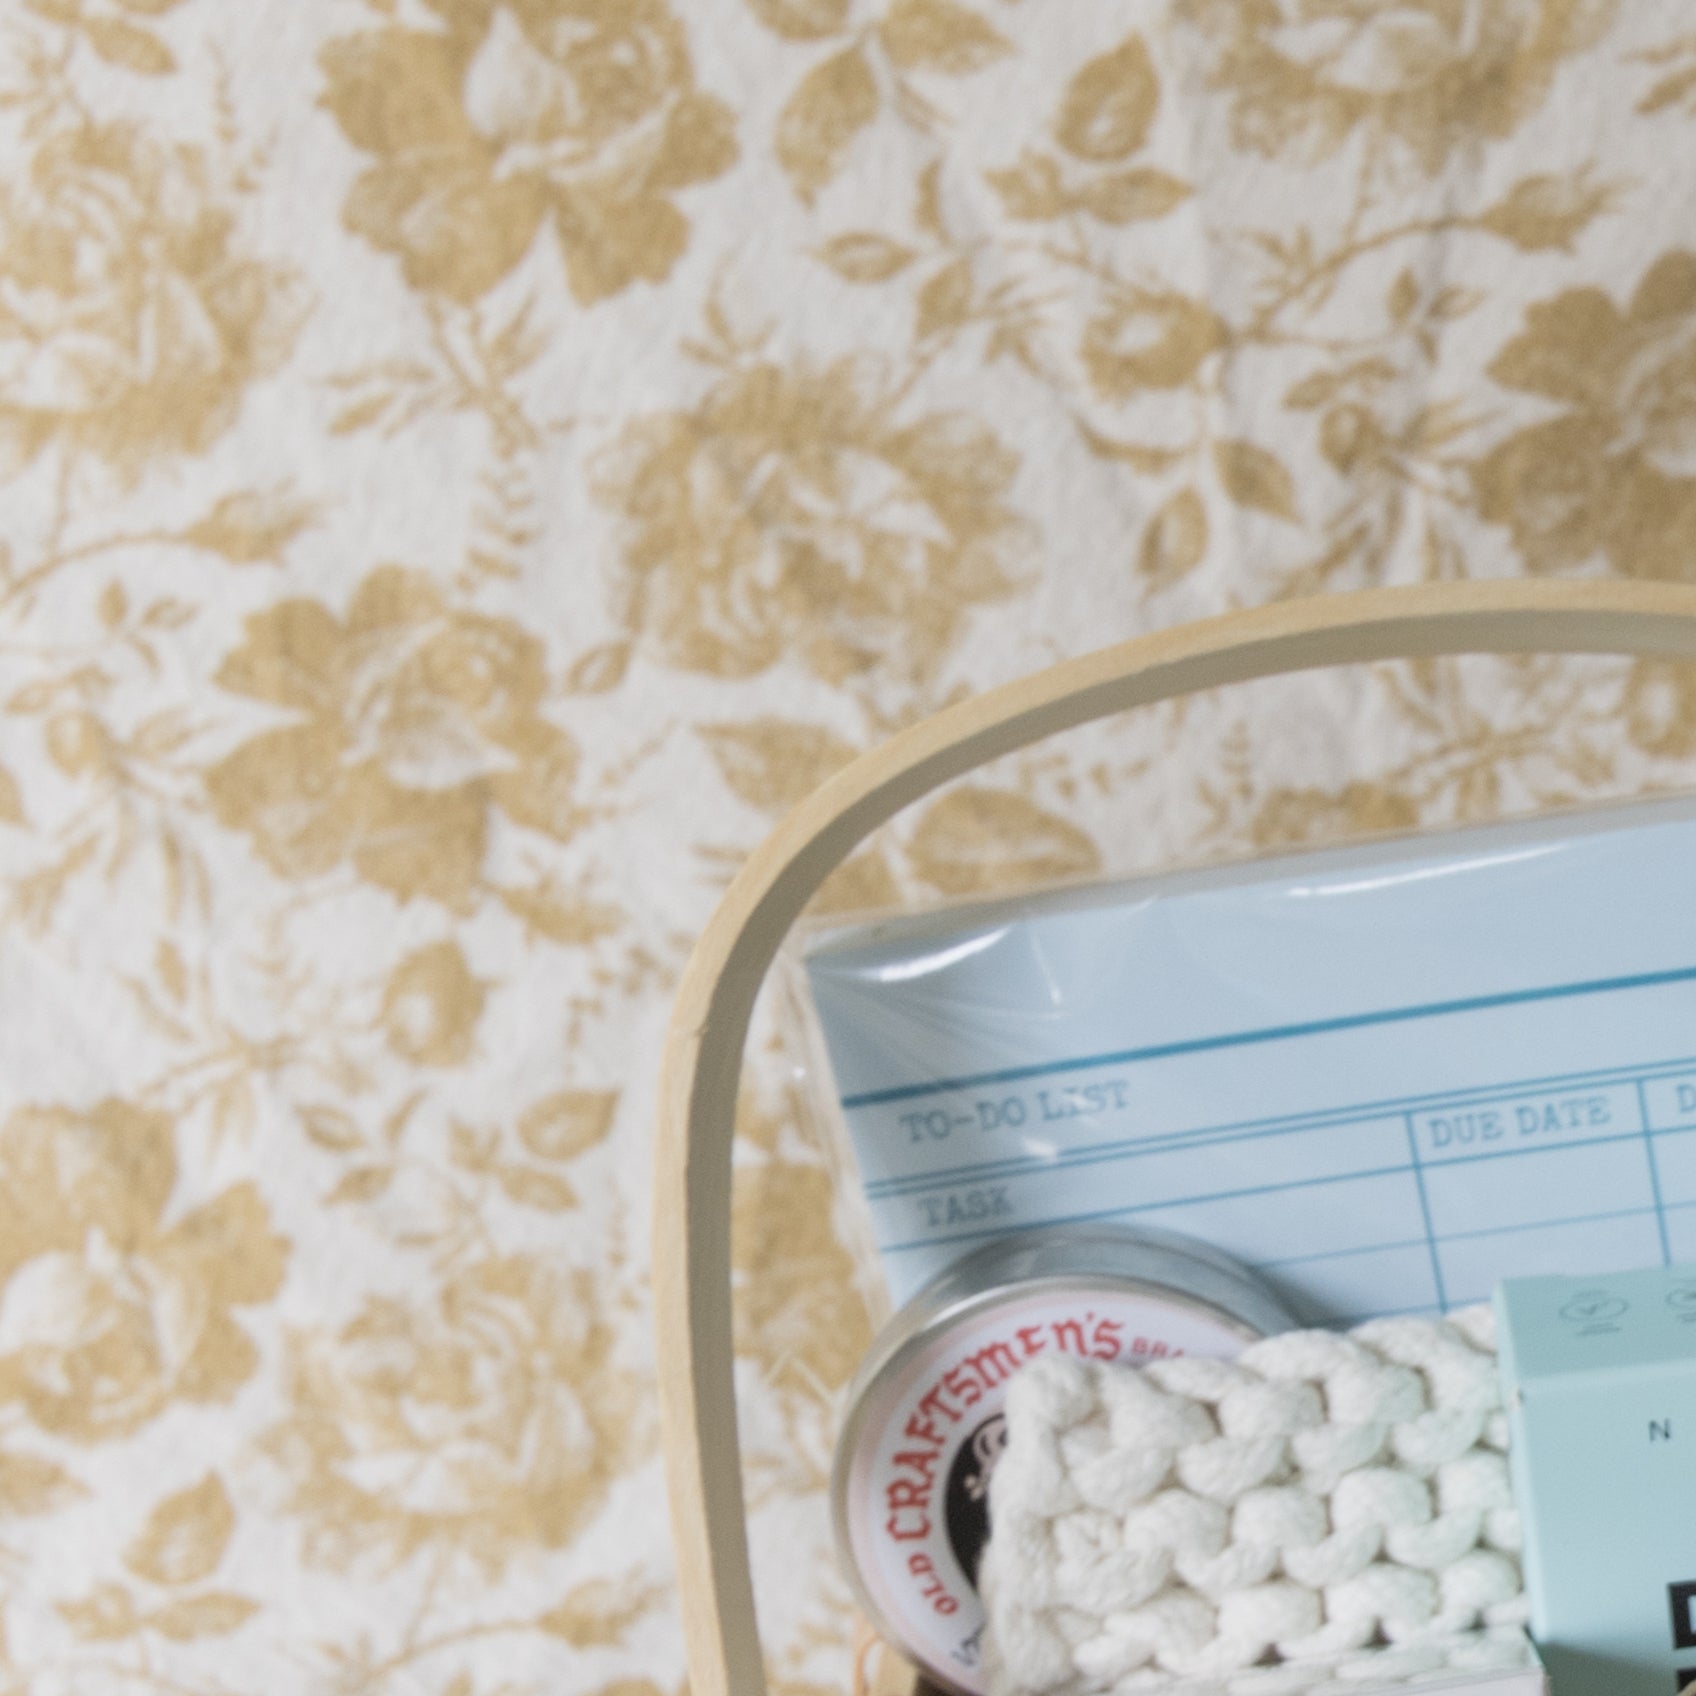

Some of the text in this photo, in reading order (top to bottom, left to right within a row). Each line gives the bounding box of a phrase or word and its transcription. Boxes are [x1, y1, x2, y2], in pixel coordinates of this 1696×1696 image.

[900, 1081, 1130, 1144] TO-DO LIST
[1429, 1095, 1611, 1148] DUE DATE
[916, 1185, 1016, 1228] TASK
[908, 1552, 960, 1617] OLD
